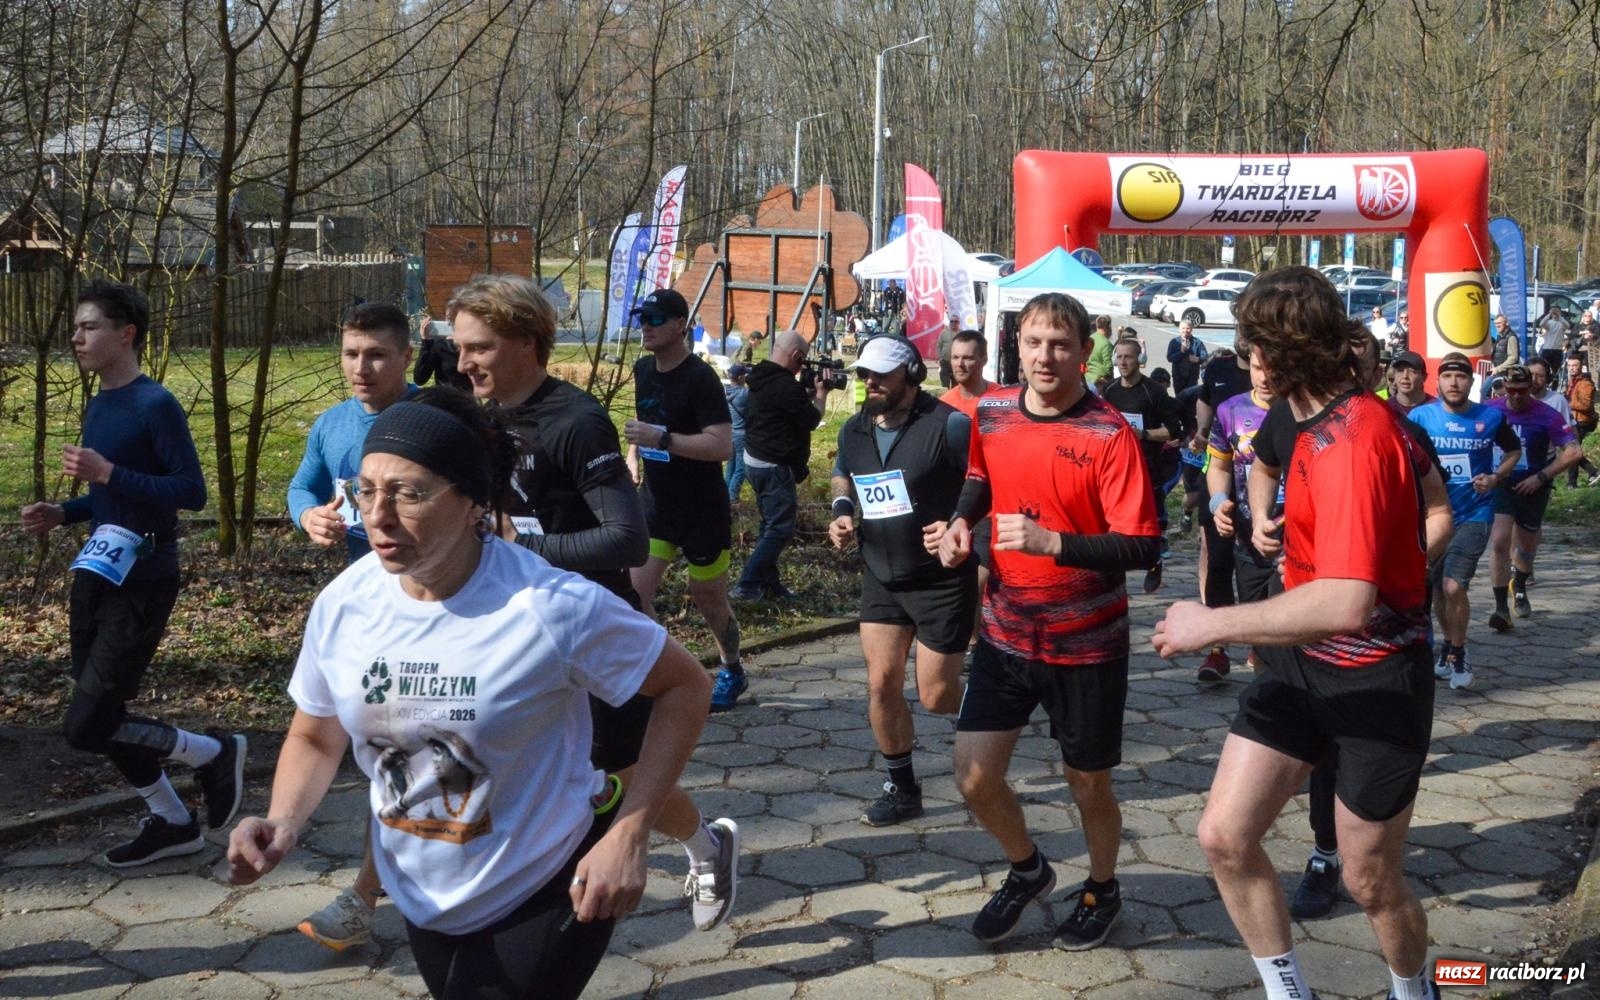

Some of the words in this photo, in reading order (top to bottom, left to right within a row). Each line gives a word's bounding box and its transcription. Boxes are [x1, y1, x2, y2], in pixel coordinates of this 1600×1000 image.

[1239, 164, 1291, 176] BIEG
[1198, 184, 1337, 201] TWARDZIELA
[1209, 205, 1322, 223] RACIBÓRZ
[1431, 436, 1491, 450] UNNERS
[864, 485, 895, 503] 102
[83, 540, 124, 564] 094
[399, 661, 439, 675] TROPEM
[399, 676, 476, 697] WILCZYM
[413, 708, 448, 720] EDYCJA
[449, 708, 476, 721] 2026
